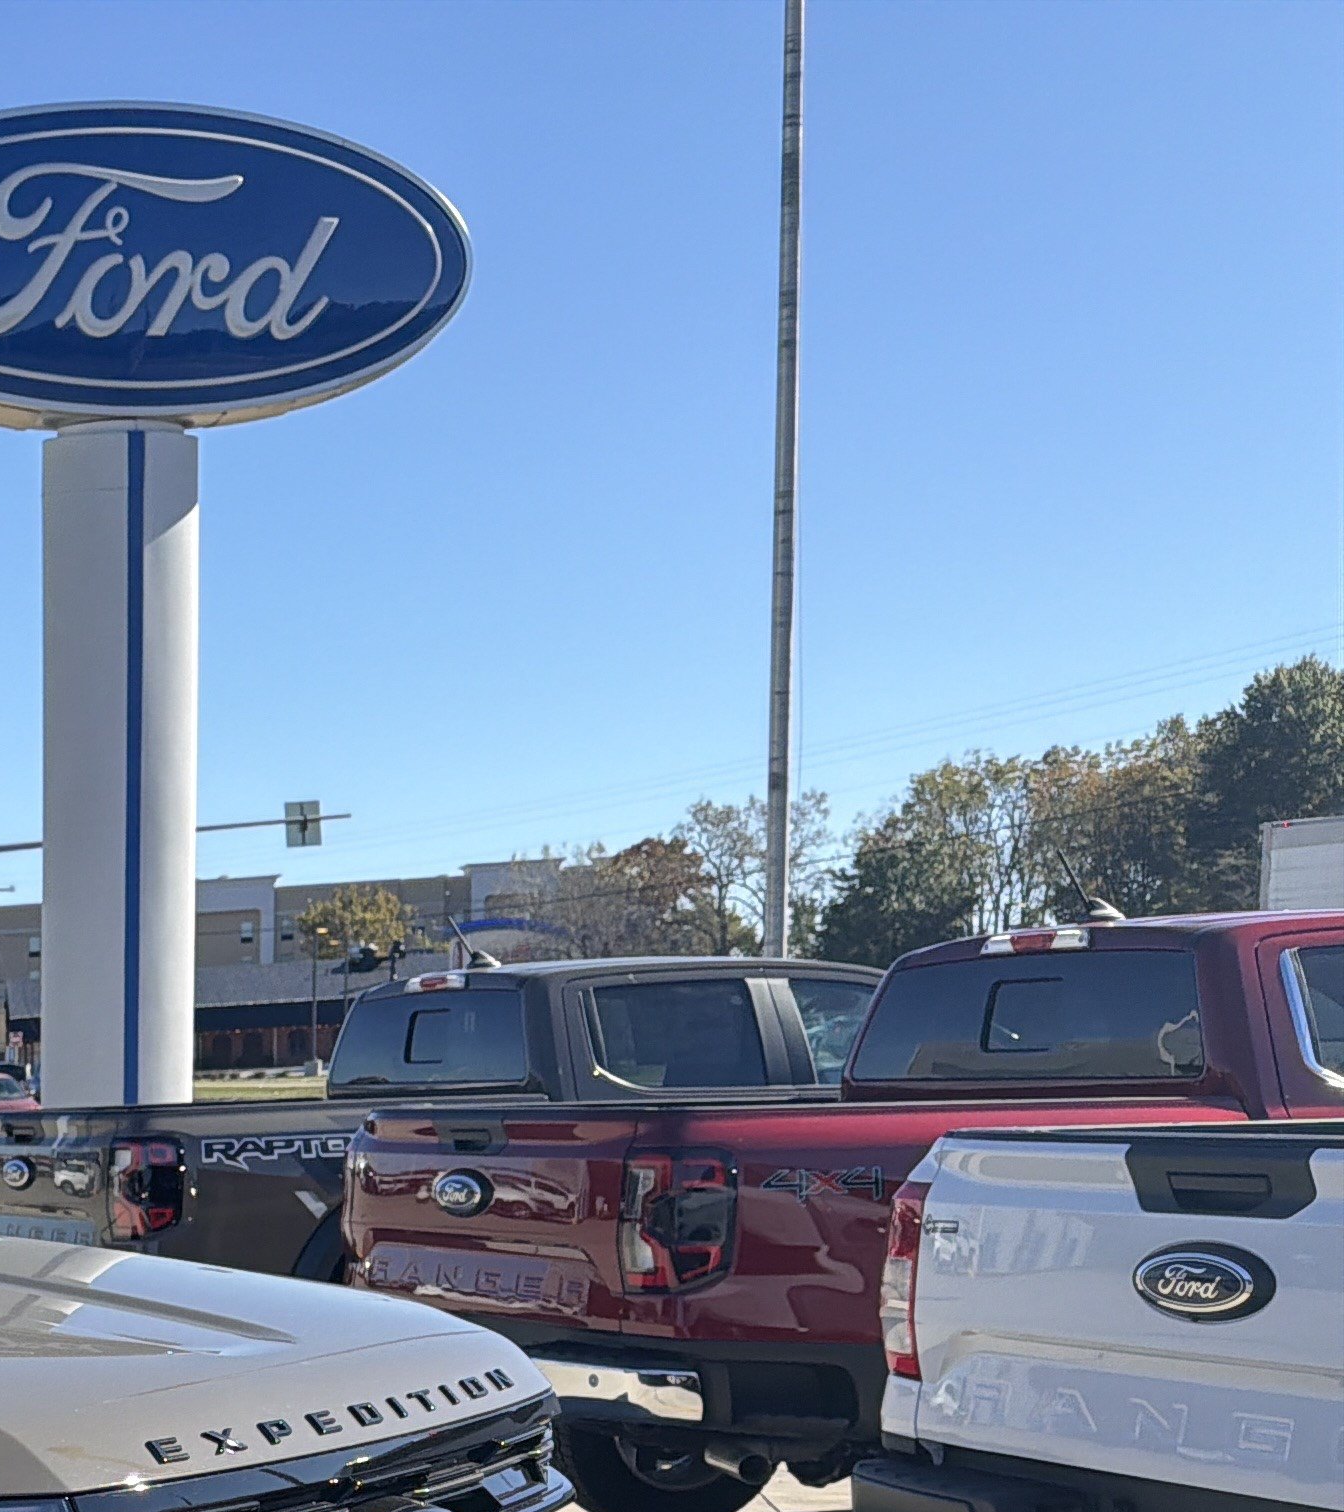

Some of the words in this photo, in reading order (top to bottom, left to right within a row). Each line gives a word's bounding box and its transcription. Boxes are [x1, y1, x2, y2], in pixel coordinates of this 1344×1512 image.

[201, 1133, 354, 1171] RAPTO
[438, 1180, 470, 1205] Ford
[370, 1256, 588, 1304] RANGER
[1158, 1263, 1221, 1300] Ford
[145, 1368, 515, 1466] EXPEDITION
